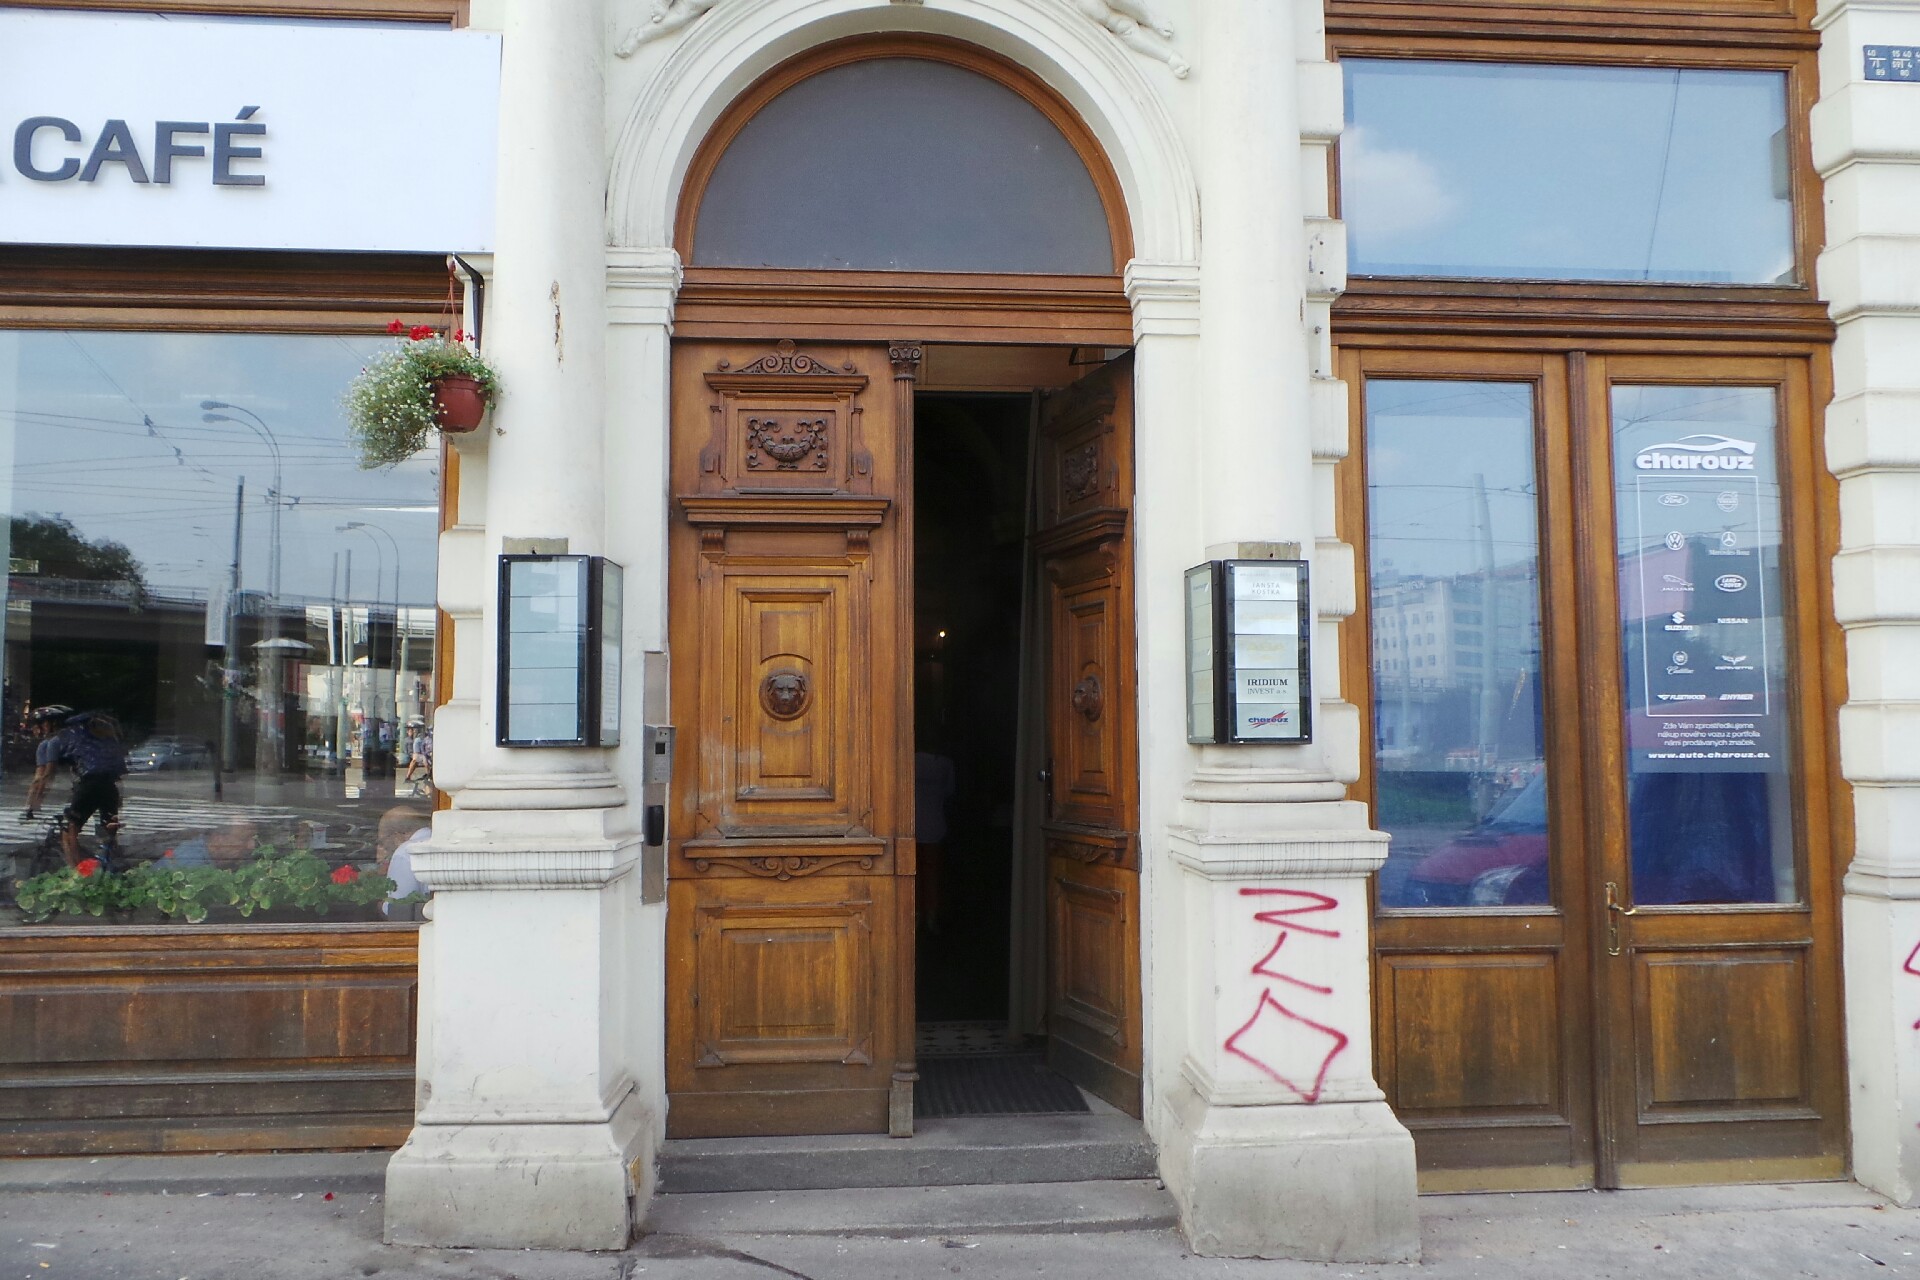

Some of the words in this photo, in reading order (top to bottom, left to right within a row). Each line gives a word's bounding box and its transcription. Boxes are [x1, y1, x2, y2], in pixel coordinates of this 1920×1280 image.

[13, 105, 267, 186] CAFÉ
[1635, 452, 1754, 470] charouz
[1247, 678, 1289, 686] IRIDIUM
